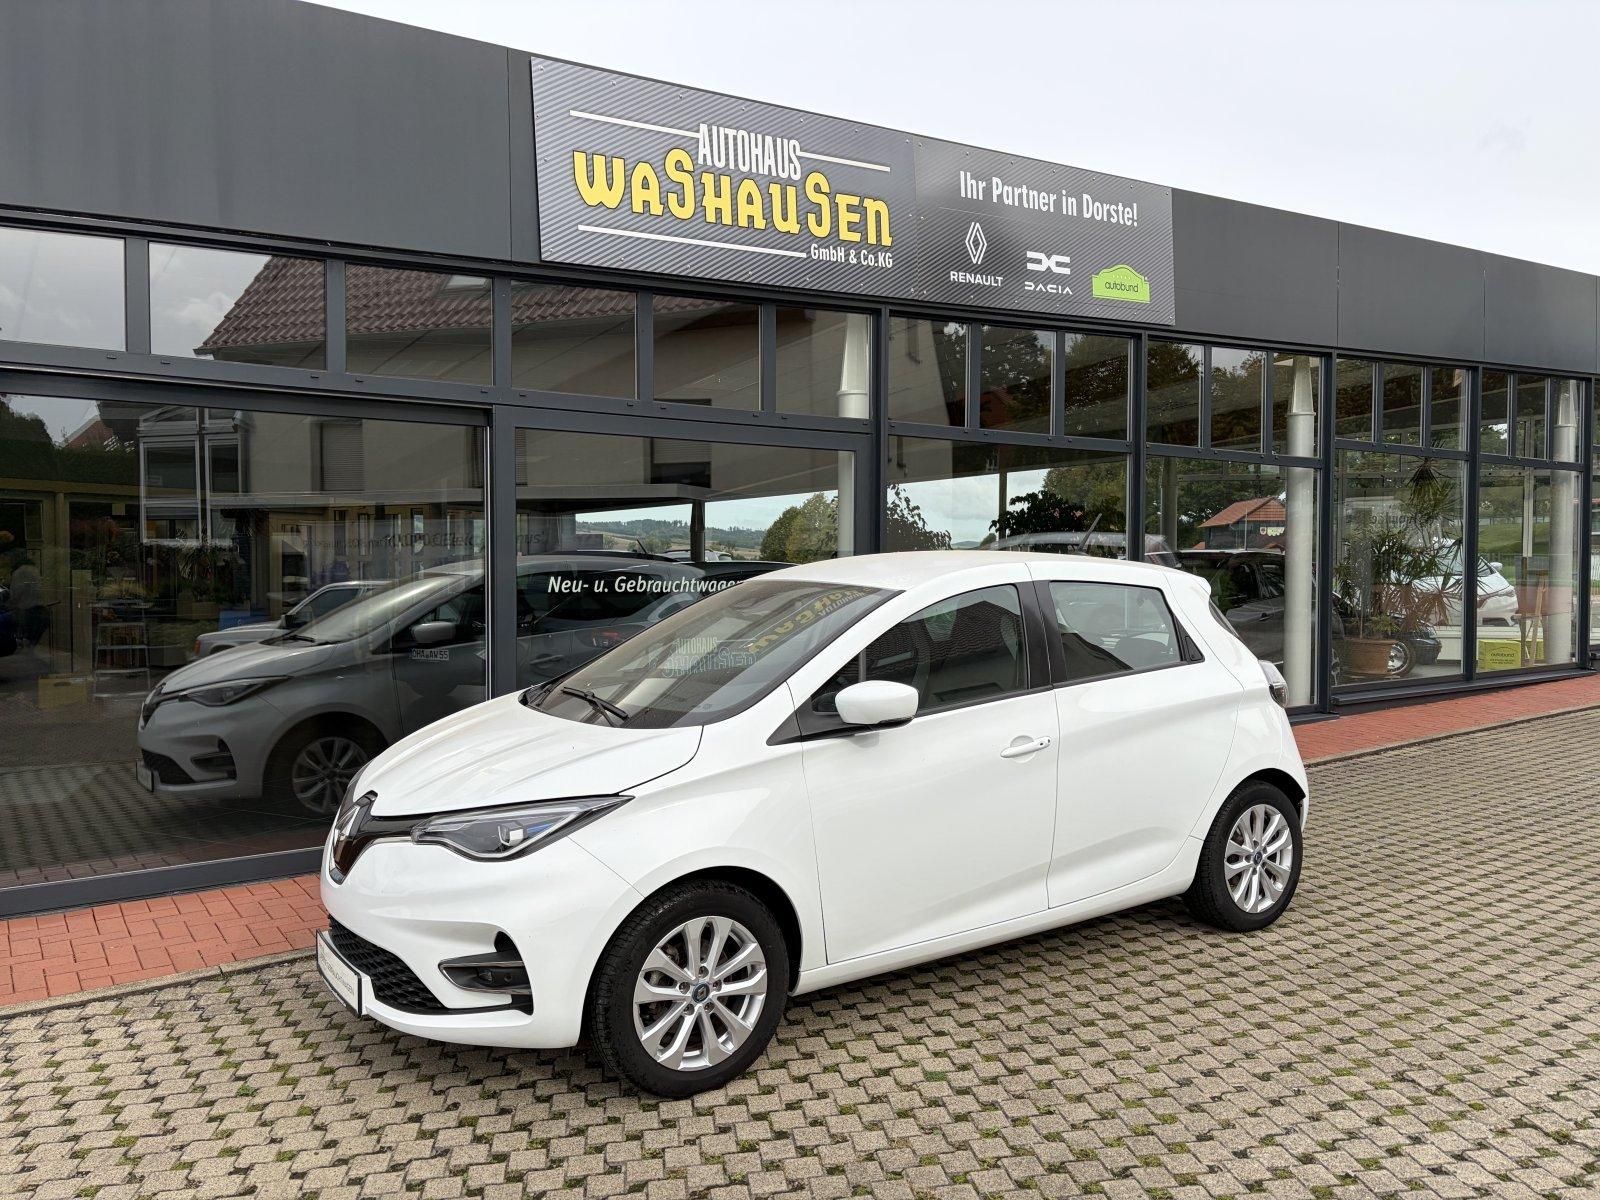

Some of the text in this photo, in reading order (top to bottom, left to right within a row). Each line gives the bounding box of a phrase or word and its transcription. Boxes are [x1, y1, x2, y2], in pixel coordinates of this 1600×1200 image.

[697, 123, 801, 180] AUTOHAUS
[959, 170, 1138, 227] Ihr Partner in Dorste!
[810, 243, 893, 269] GmbH & Co.KG
[950, 270, 1003, 287] RENAULT
[1104, 281, 1139, 293] autobund
[1024, 281, 1073, 295] DACIA
[547, 575, 743, 593] Neu- u. Gebrauchtwage
